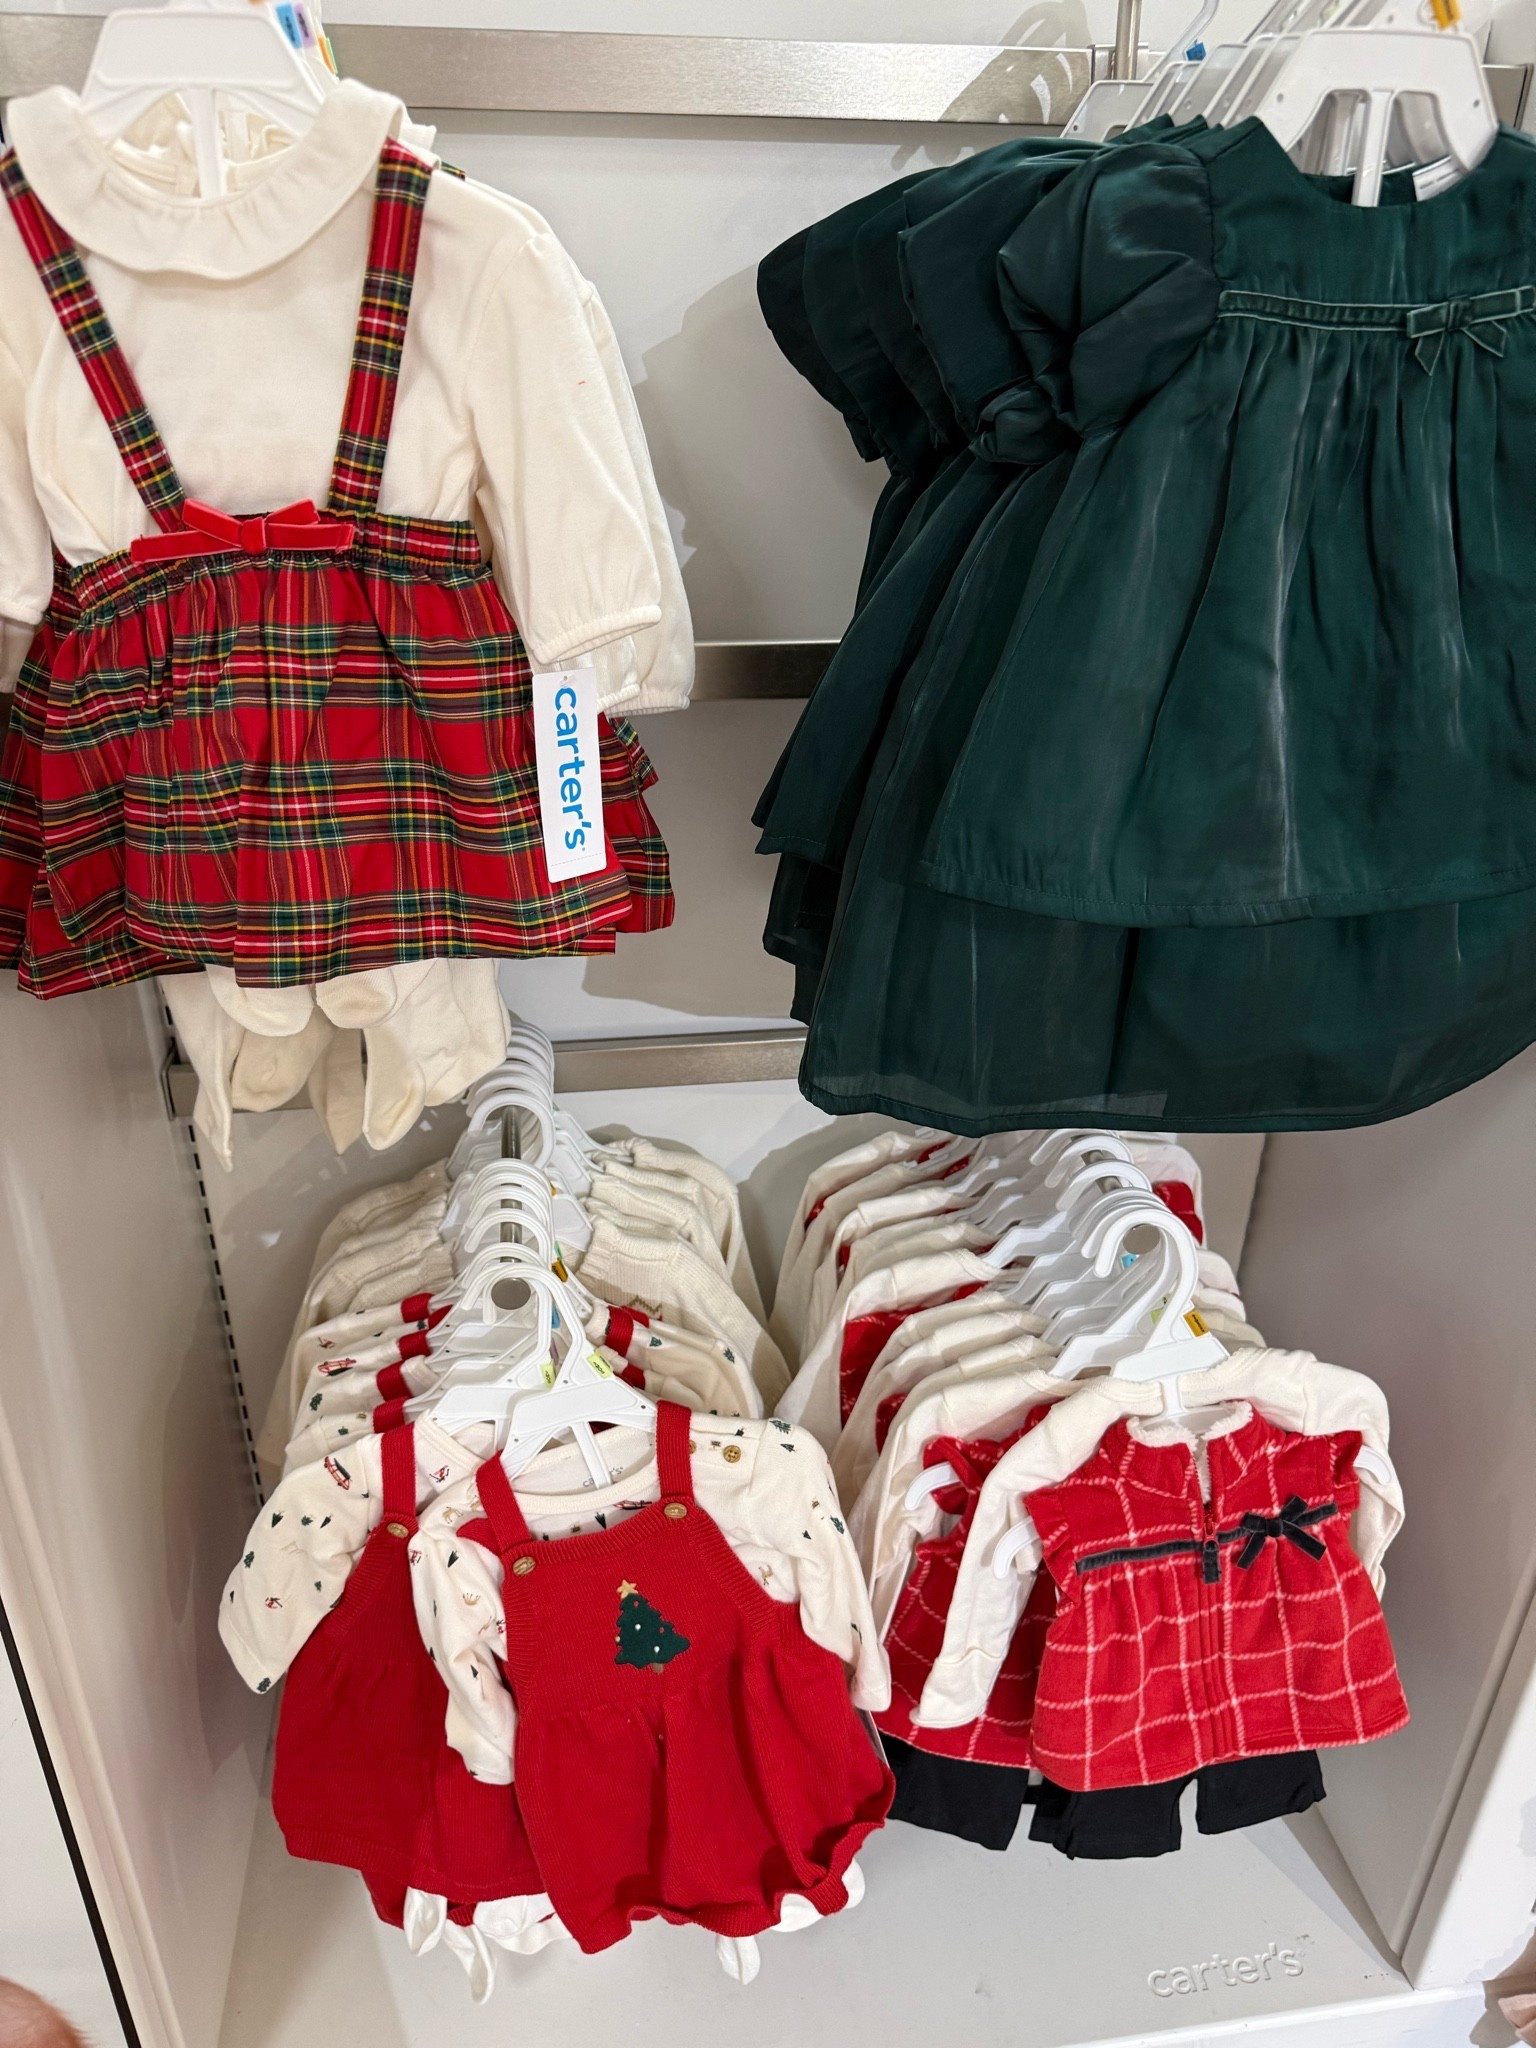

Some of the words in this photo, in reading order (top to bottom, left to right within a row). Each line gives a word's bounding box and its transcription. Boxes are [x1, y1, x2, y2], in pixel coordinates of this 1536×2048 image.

[554, 687, 592, 850] carter's
[582, 1467, 622, 1488] car's
[1148, 1942, 1304, 1997] carter's
